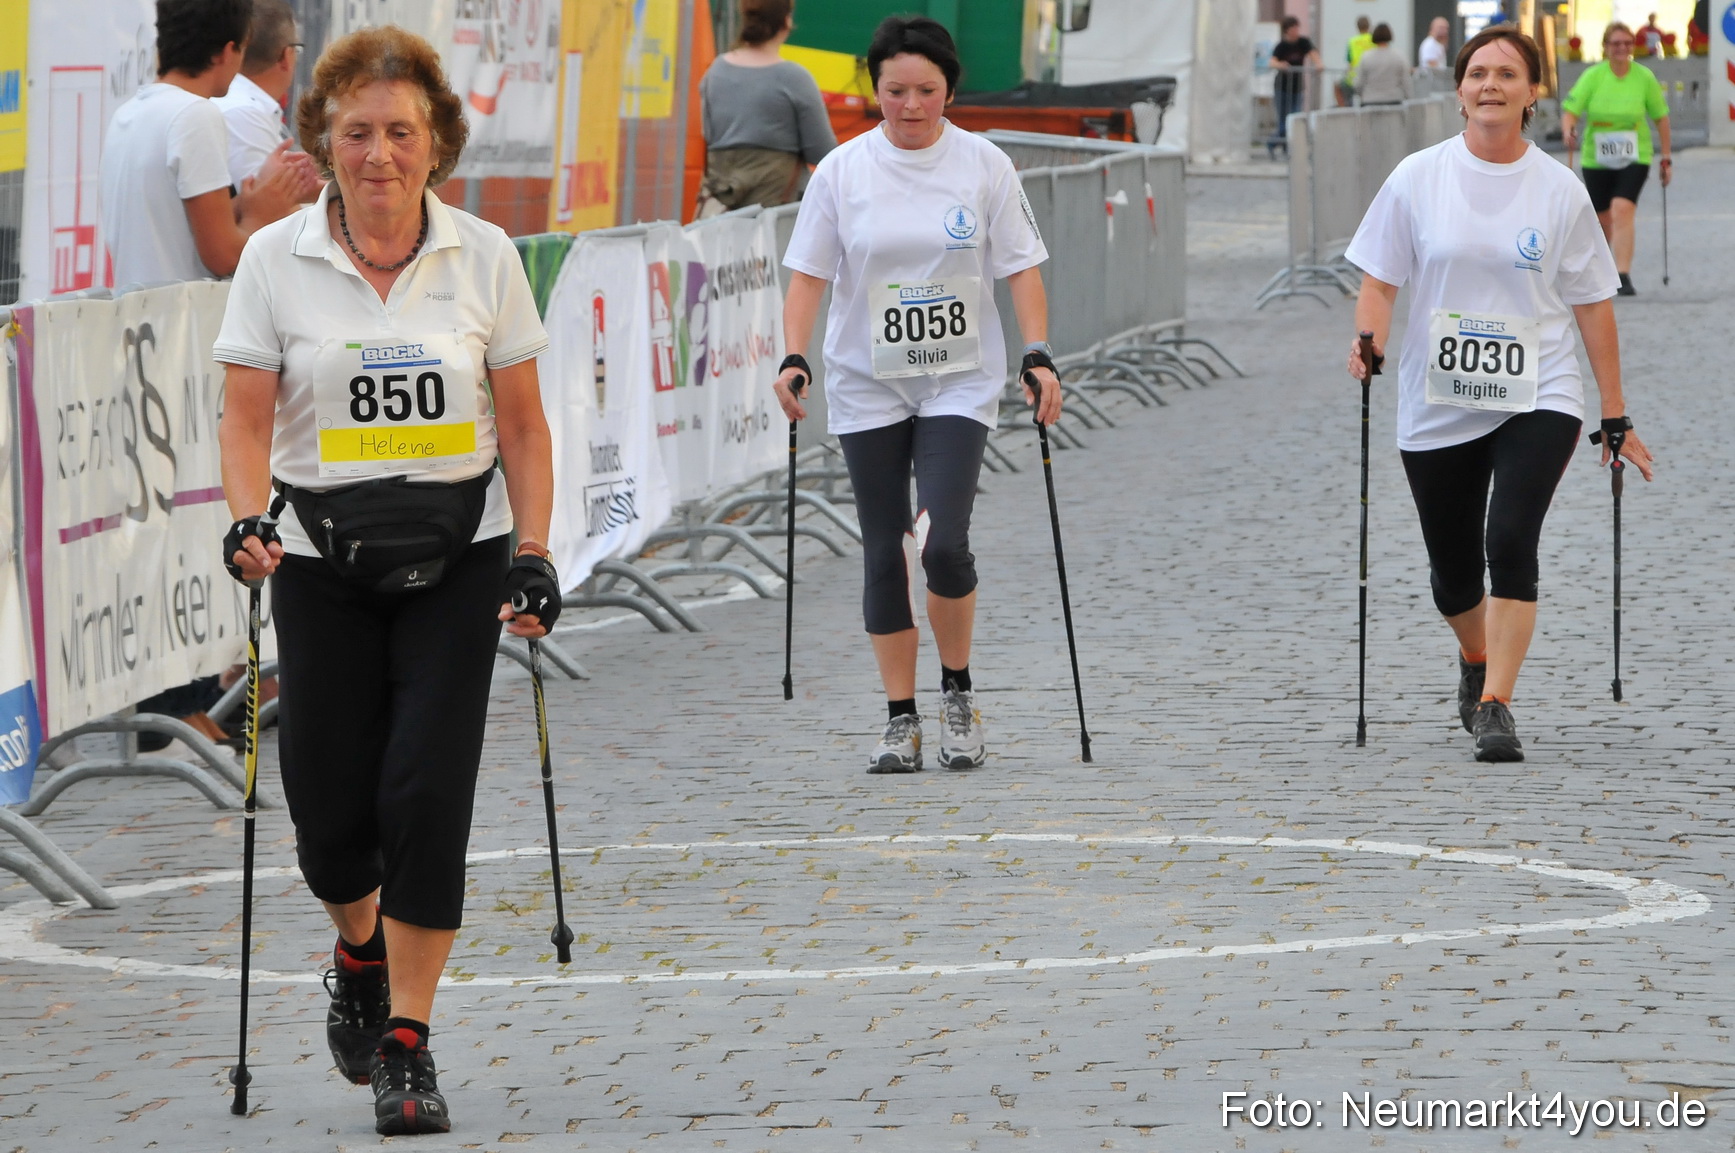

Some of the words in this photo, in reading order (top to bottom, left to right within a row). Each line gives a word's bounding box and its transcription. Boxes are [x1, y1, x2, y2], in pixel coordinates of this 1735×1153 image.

[1600, 141, 1634, 155] 8070
[900, 284, 945, 299] BOCK
[884, 301, 967, 343] 8058
[1459, 318, 1506, 333] BOCK
[361, 343, 425, 362] BOCK
[907, 347, 948, 365] Silvia
[1438, 336, 1525, 376] 8030
[349, 371, 446, 423] 850
[1453, 379, 1508, 400] Brigitte
[360, 433, 436, 456] Helene
